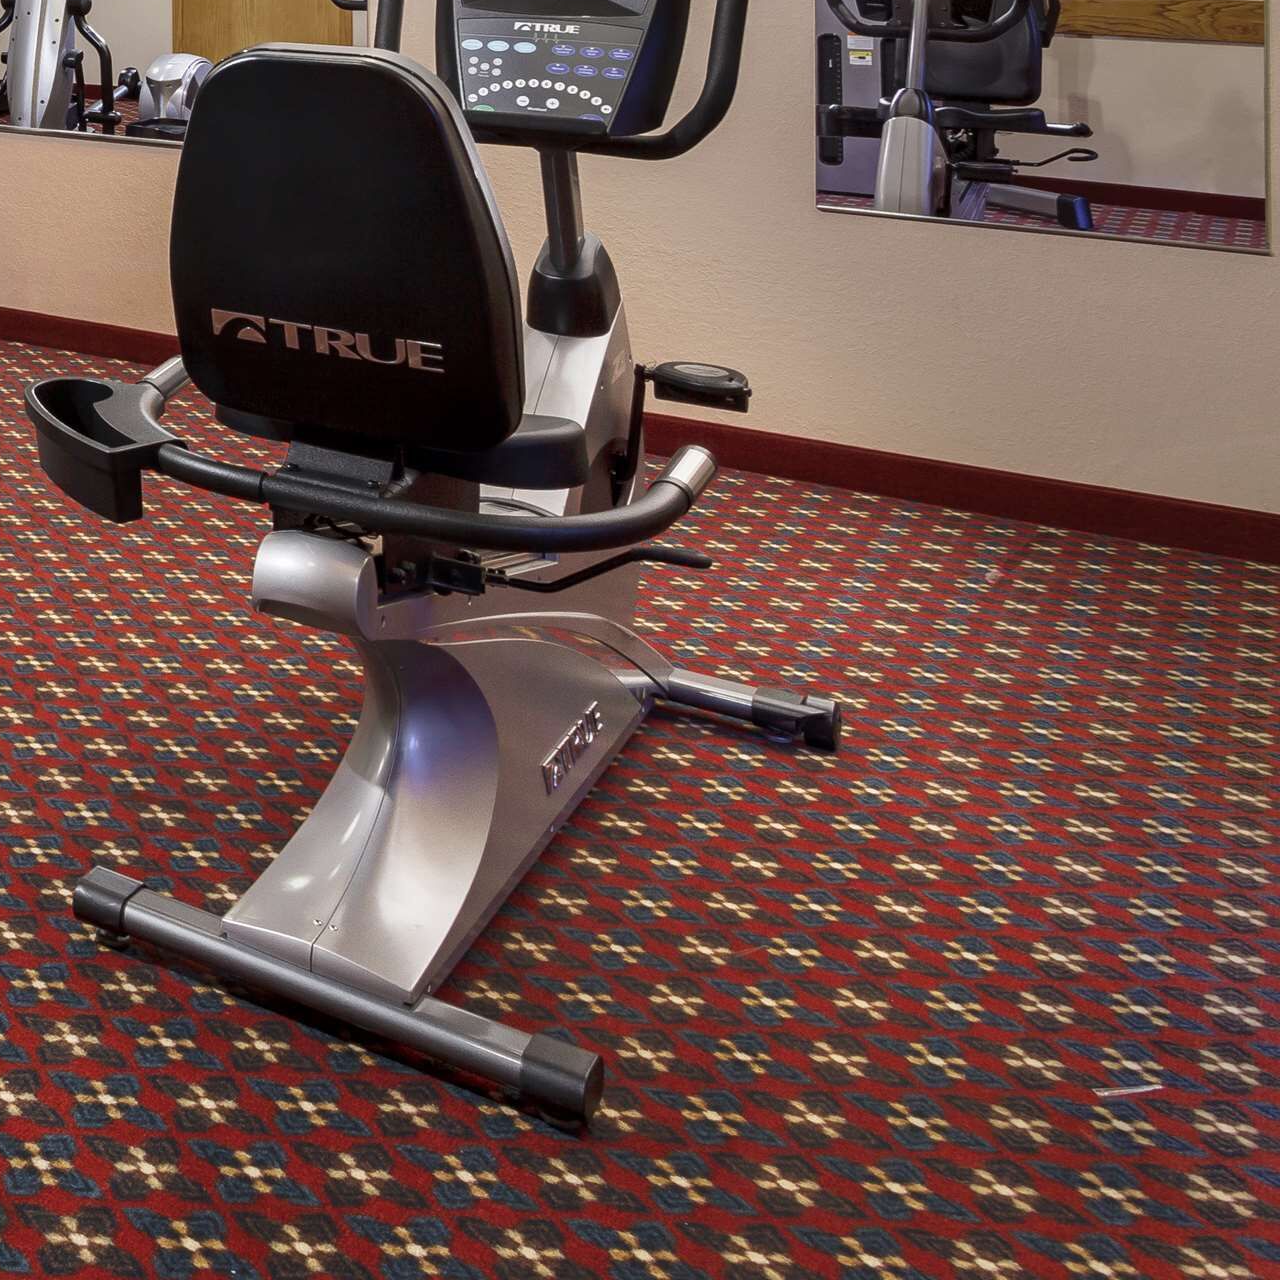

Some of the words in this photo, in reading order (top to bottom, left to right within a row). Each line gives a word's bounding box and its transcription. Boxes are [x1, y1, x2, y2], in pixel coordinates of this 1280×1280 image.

[532, 23, 581, 34] TRUE
[269, 318, 445, 373] TRUE
[558, 700, 603, 774] TRUE
